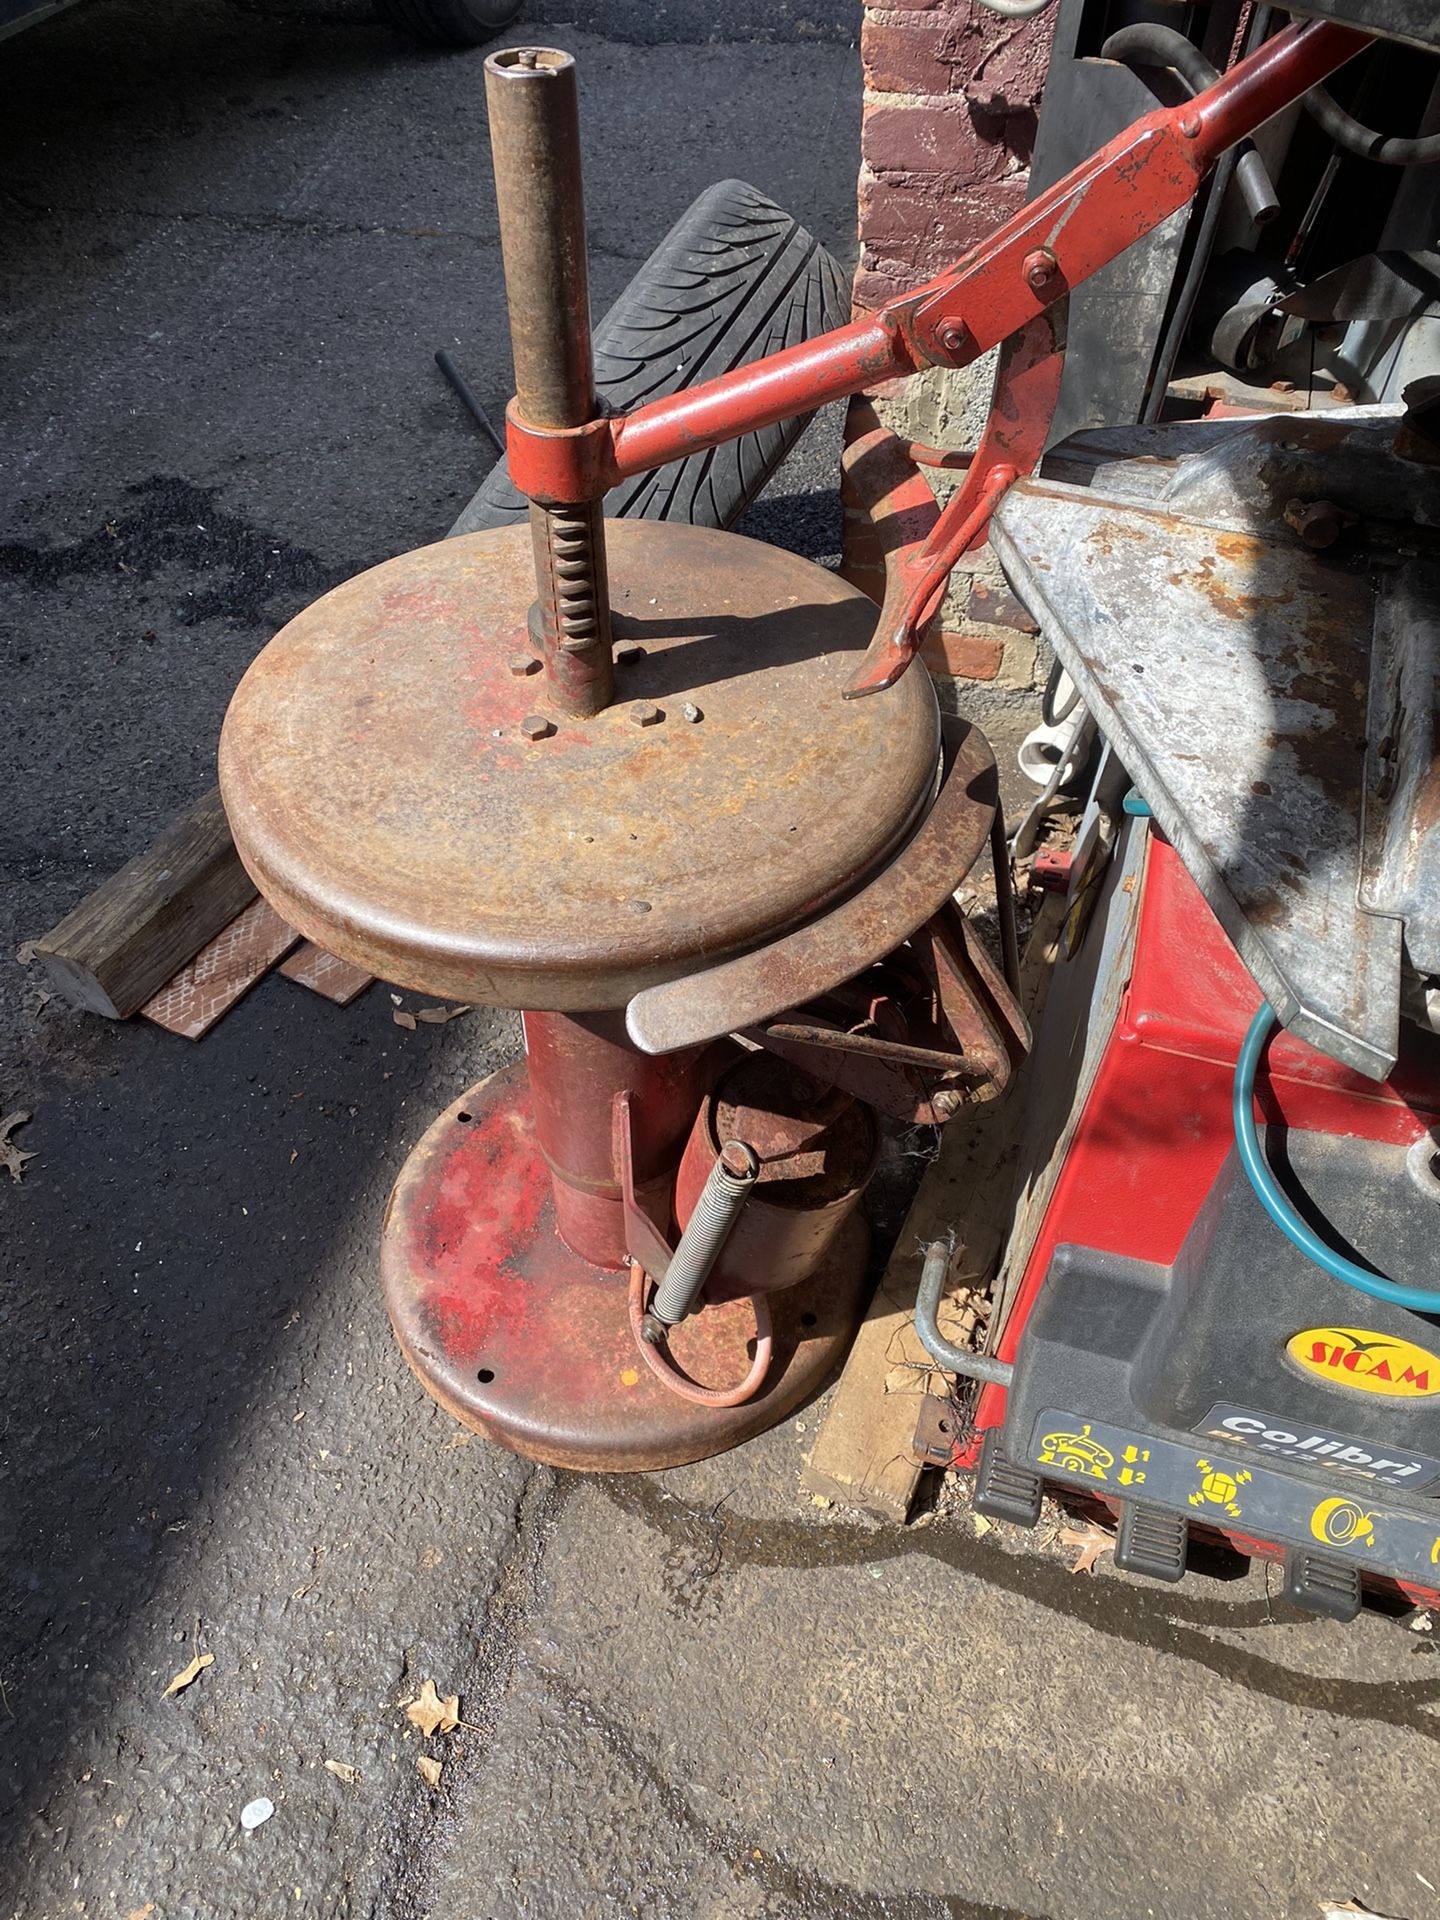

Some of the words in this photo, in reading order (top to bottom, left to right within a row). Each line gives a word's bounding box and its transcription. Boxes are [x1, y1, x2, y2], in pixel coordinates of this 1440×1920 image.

[1305, 1342, 1429, 1390] SICAM
[1083, 1424, 1092, 1436] 1
[1141, 1450, 1151, 1462] 1
[1067, 1460, 1079, 1472] 2
[1135, 1472, 1147, 1484] 2
